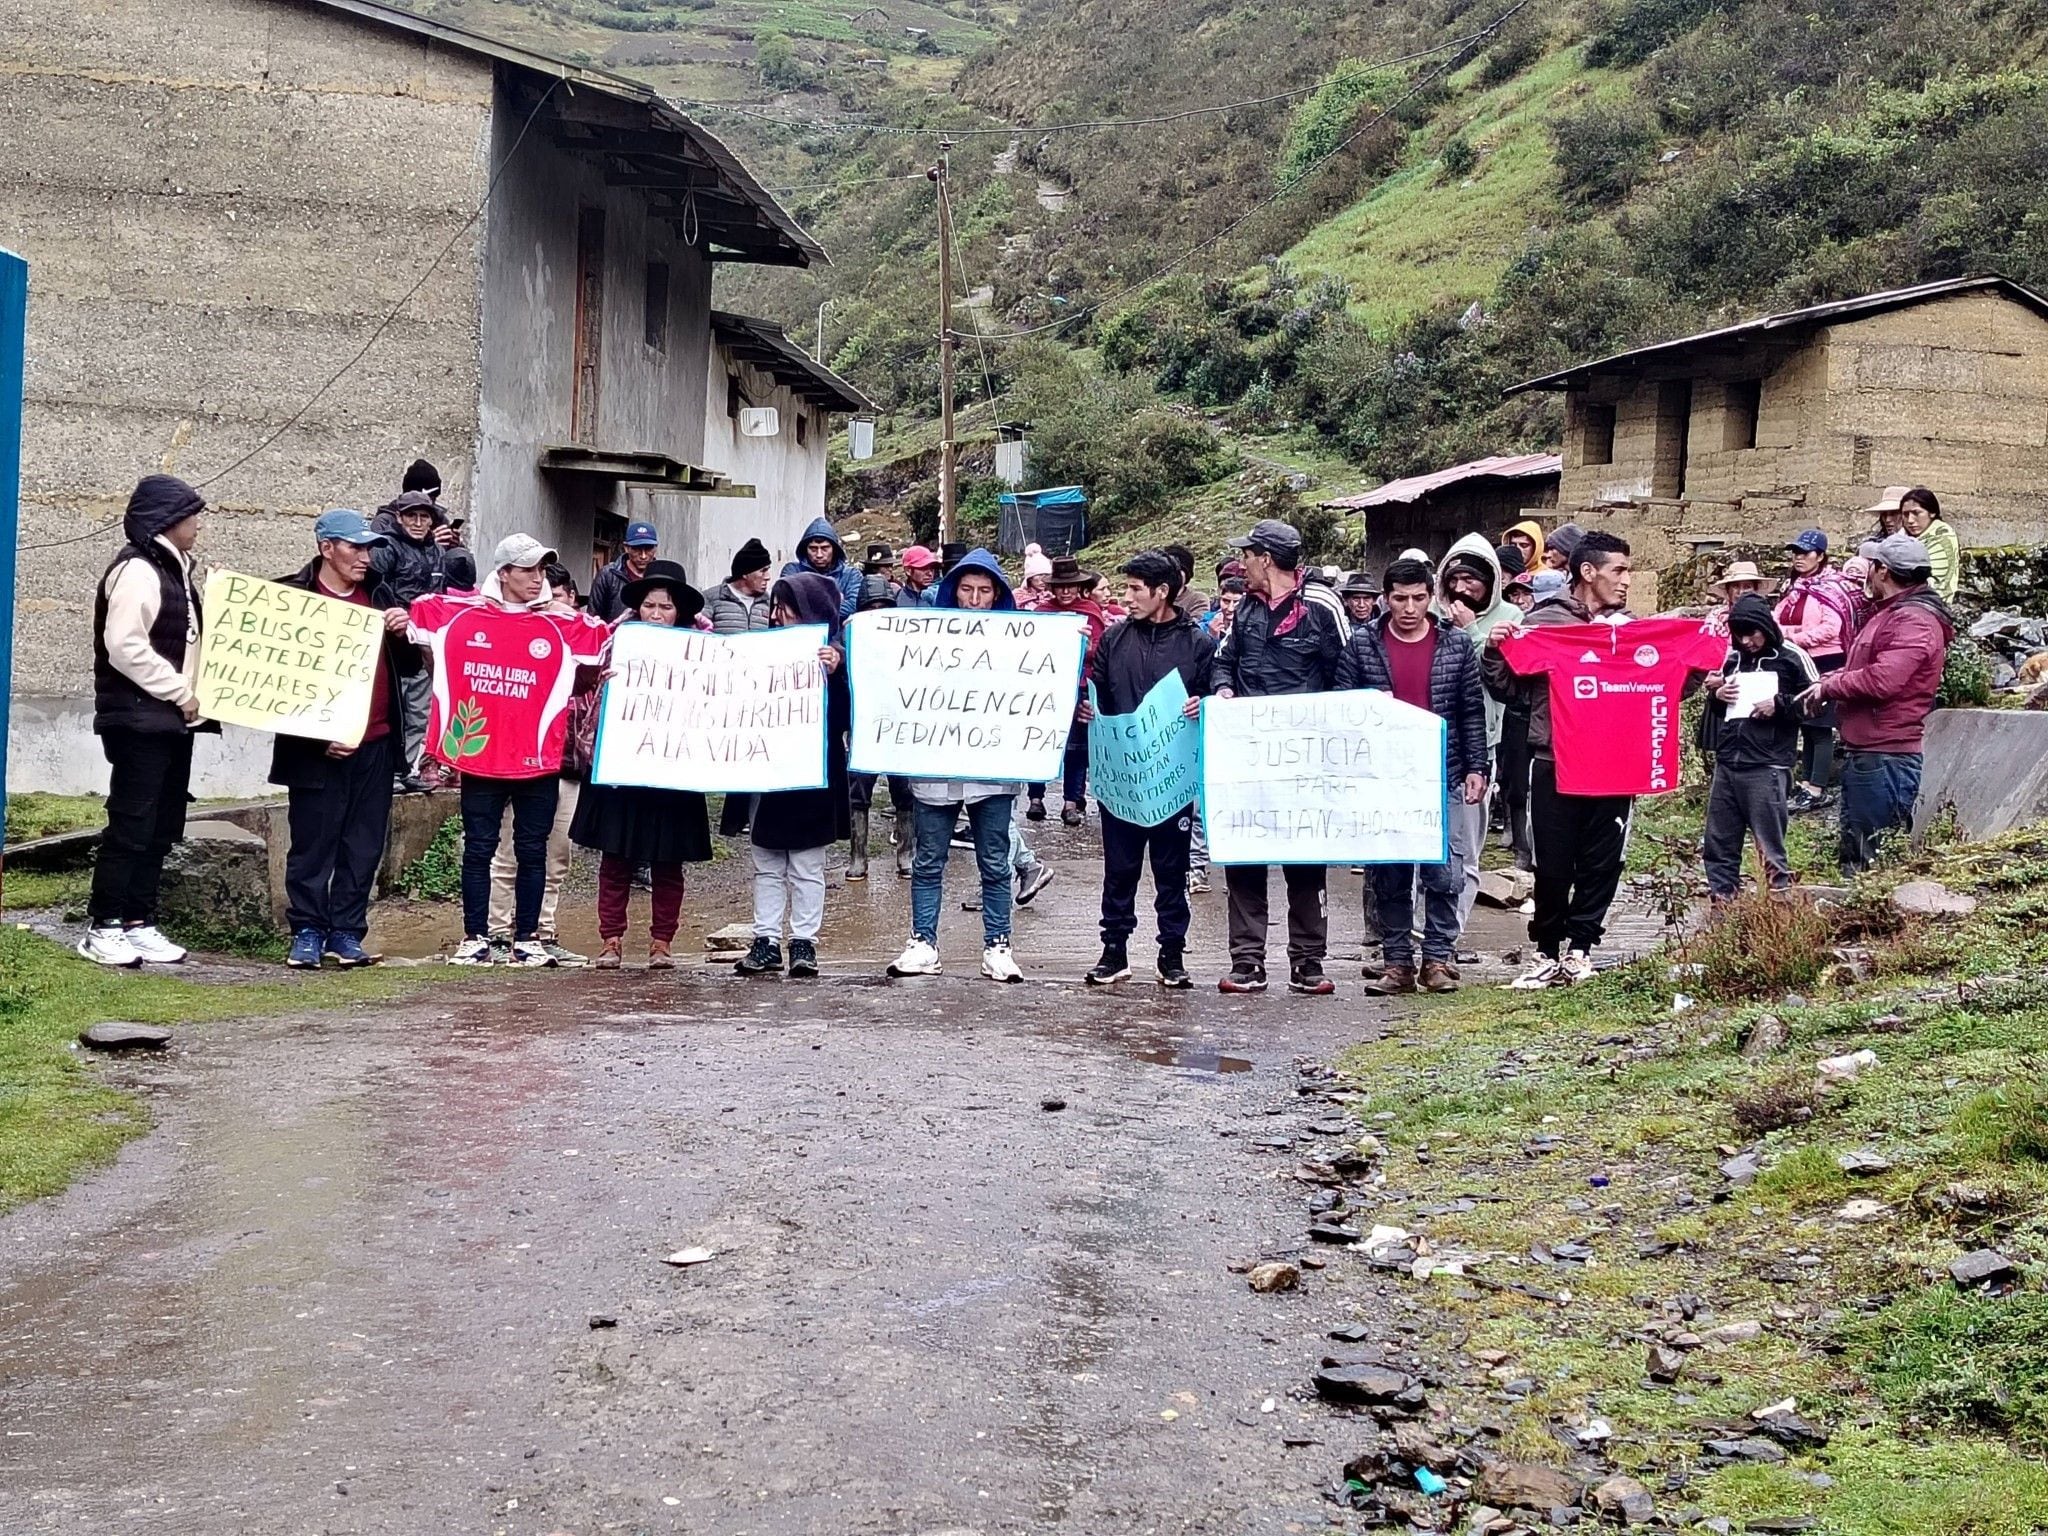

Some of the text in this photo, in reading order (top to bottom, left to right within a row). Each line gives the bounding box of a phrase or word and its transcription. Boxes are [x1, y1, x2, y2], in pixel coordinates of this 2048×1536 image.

[225, 576, 378, 635] BASTA DE
[214, 608, 326, 649] ABUSOS
[1004, 620, 1036, 638] NO
[209, 633, 290, 666] PARTE
[294, 650, 327, 671] DE
[1018, 650, 1056, 675] LA
[202, 660, 342, 706] MILITARES Y
[463, 661, 537, 686] BUENA LIBRA
[470, 677, 529, 700] VIZCATAN
[1599, 681, 1666, 693] TeamViewer
[898, 685, 1056, 716] VIOLENCIA
[636, 727, 770, 762] A LA VIDA
[873, 716, 1068, 751] PEDIMOS PAZ
[1124, 715, 1186, 767] NUESTROS
[1650, 695, 1668, 790] PUCACOLPA
[1247, 736, 1373, 767] JUSTICIA
[1295, 774, 1358, 796] PARA
